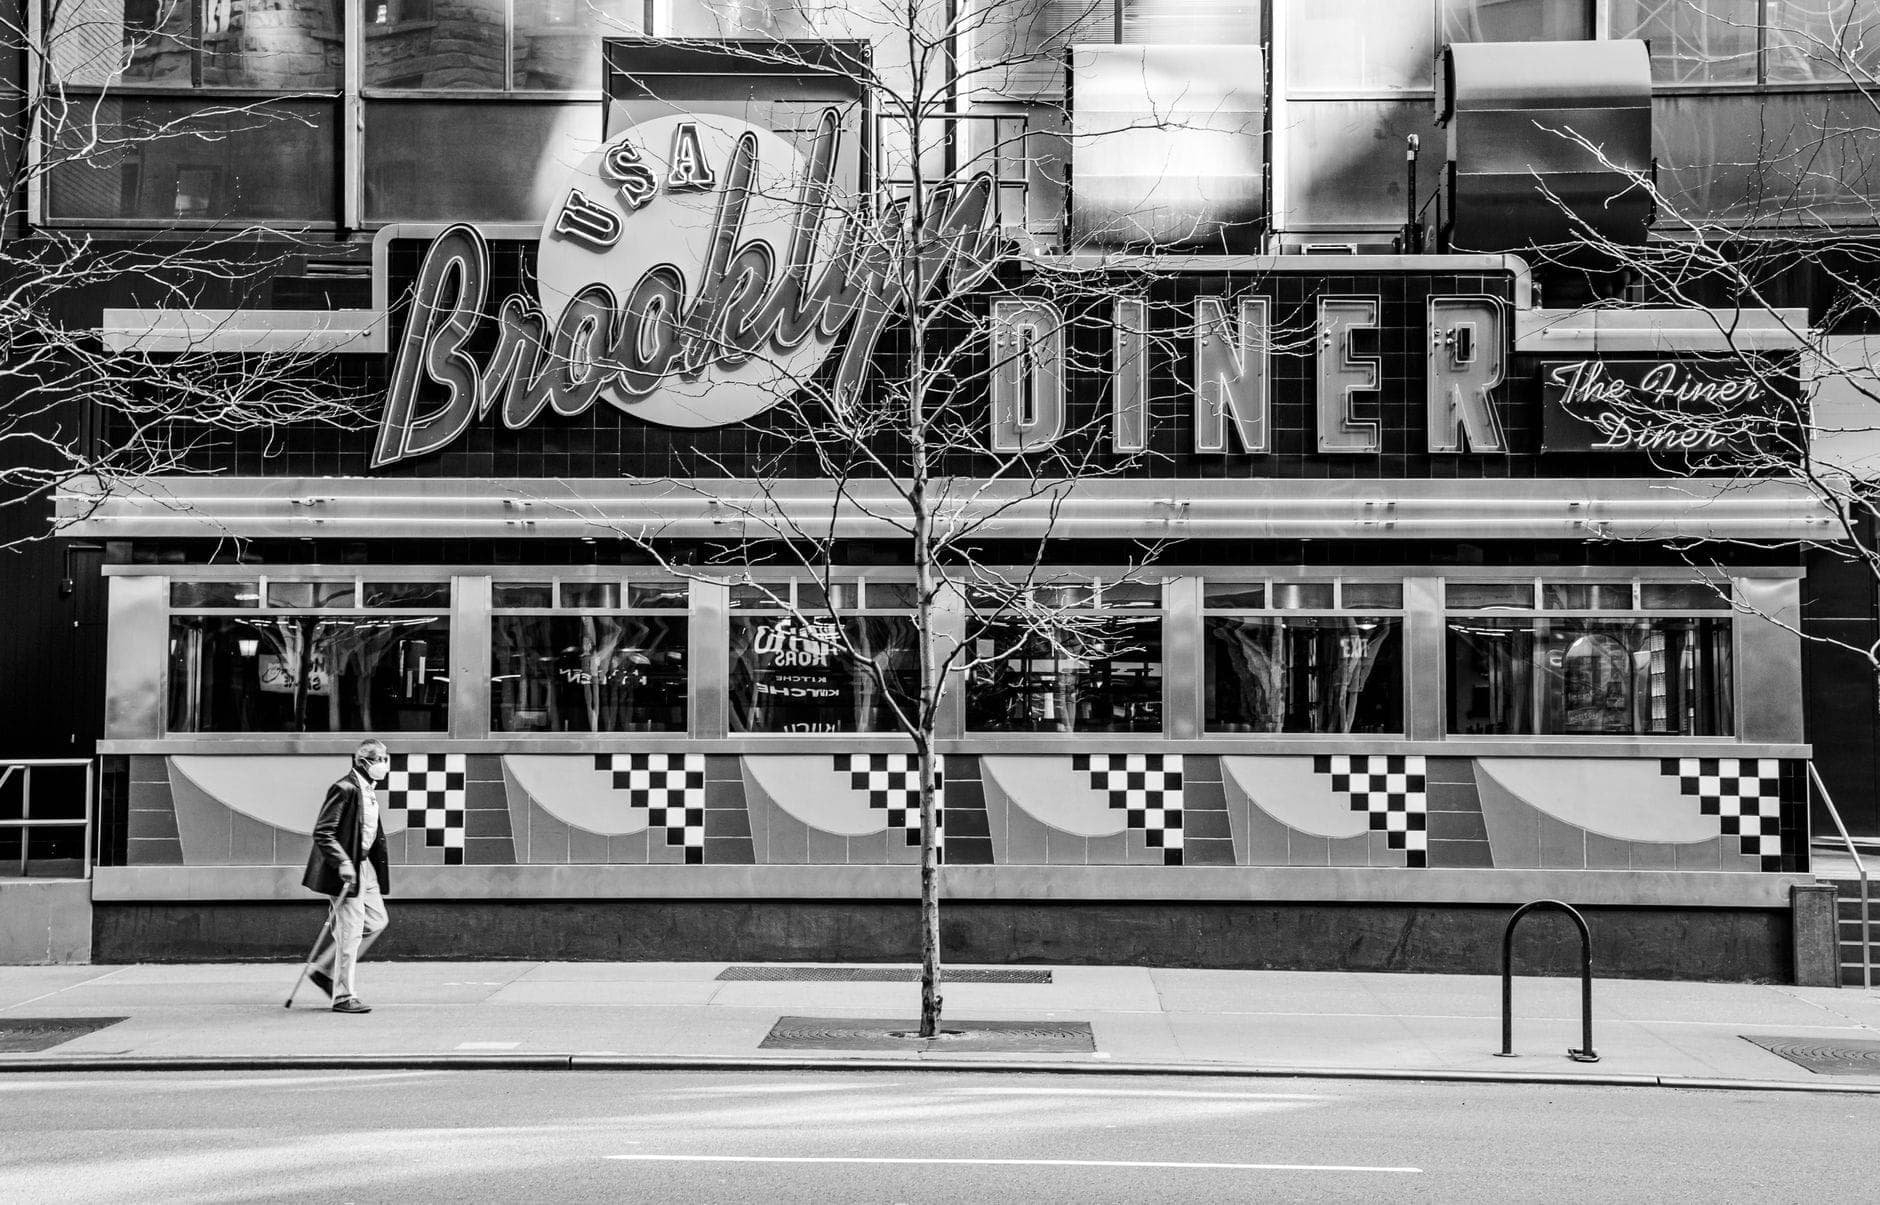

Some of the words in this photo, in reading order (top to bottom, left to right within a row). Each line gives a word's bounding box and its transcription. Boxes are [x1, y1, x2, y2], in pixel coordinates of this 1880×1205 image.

[369, 105, 1002, 470] Brooklyn
[989, 293, 1509, 455] DINER
[1551, 360, 1631, 405] The
[1640, 362, 1766, 404] Finer
[1590, 411, 1726, 449] Diner
